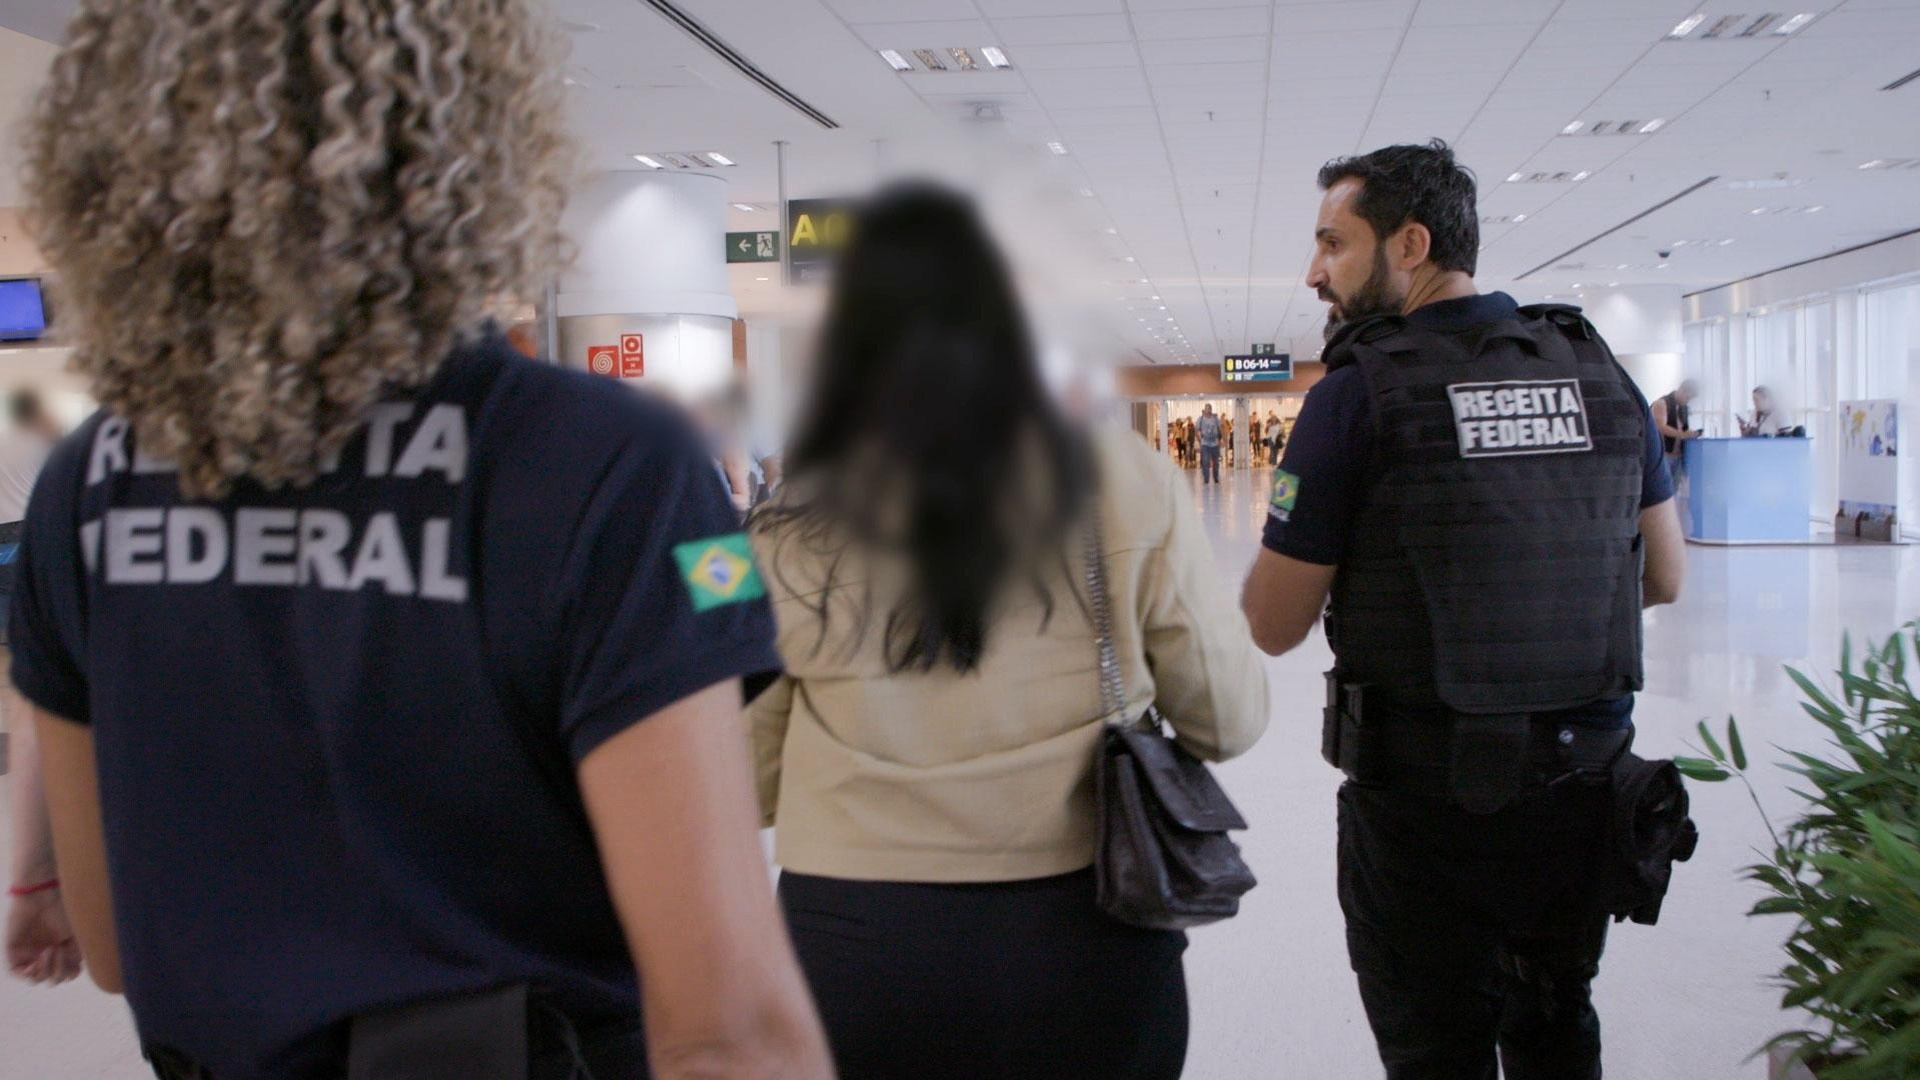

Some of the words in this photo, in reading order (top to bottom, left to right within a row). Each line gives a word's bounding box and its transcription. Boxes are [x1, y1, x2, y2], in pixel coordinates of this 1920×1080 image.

[1235, 359, 1242, 370] B
[1243, 358, 1269, 370] 06-14
[1454, 386, 1580, 418] RECEITA
[1460, 416, 1586, 449] FEDERAL
